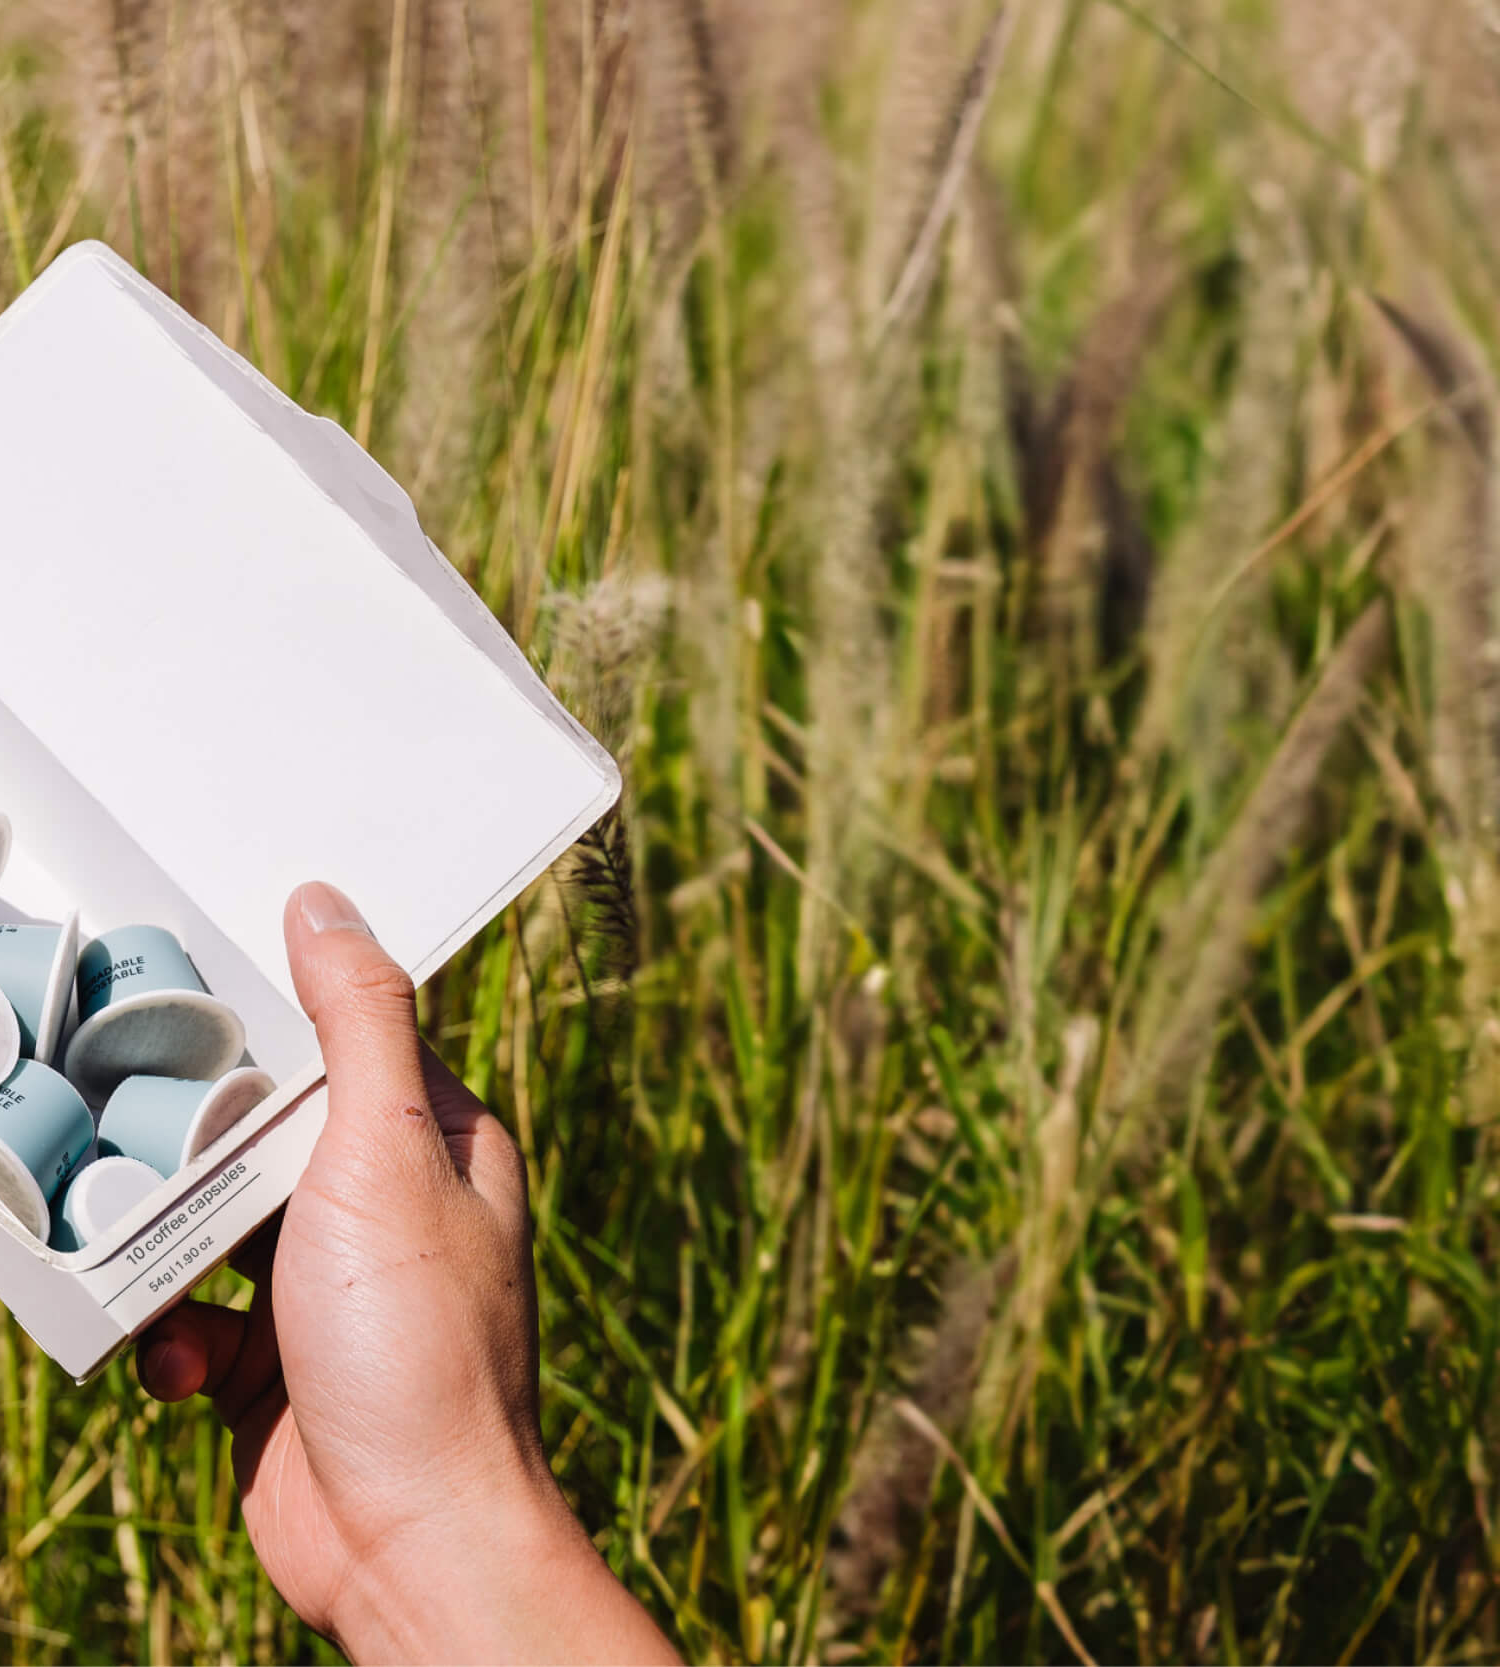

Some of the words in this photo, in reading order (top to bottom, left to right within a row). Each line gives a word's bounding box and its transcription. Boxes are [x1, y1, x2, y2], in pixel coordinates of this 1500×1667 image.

[126, 1246, 145, 1265] 10
[145, 1212, 188, 1251] coffee
[187, 1161, 247, 1215] capsules
[148, 1271, 174, 1293] 54g
[174, 1246, 200, 1270] 1.90
[199, 1235, 214, 1251] oz
